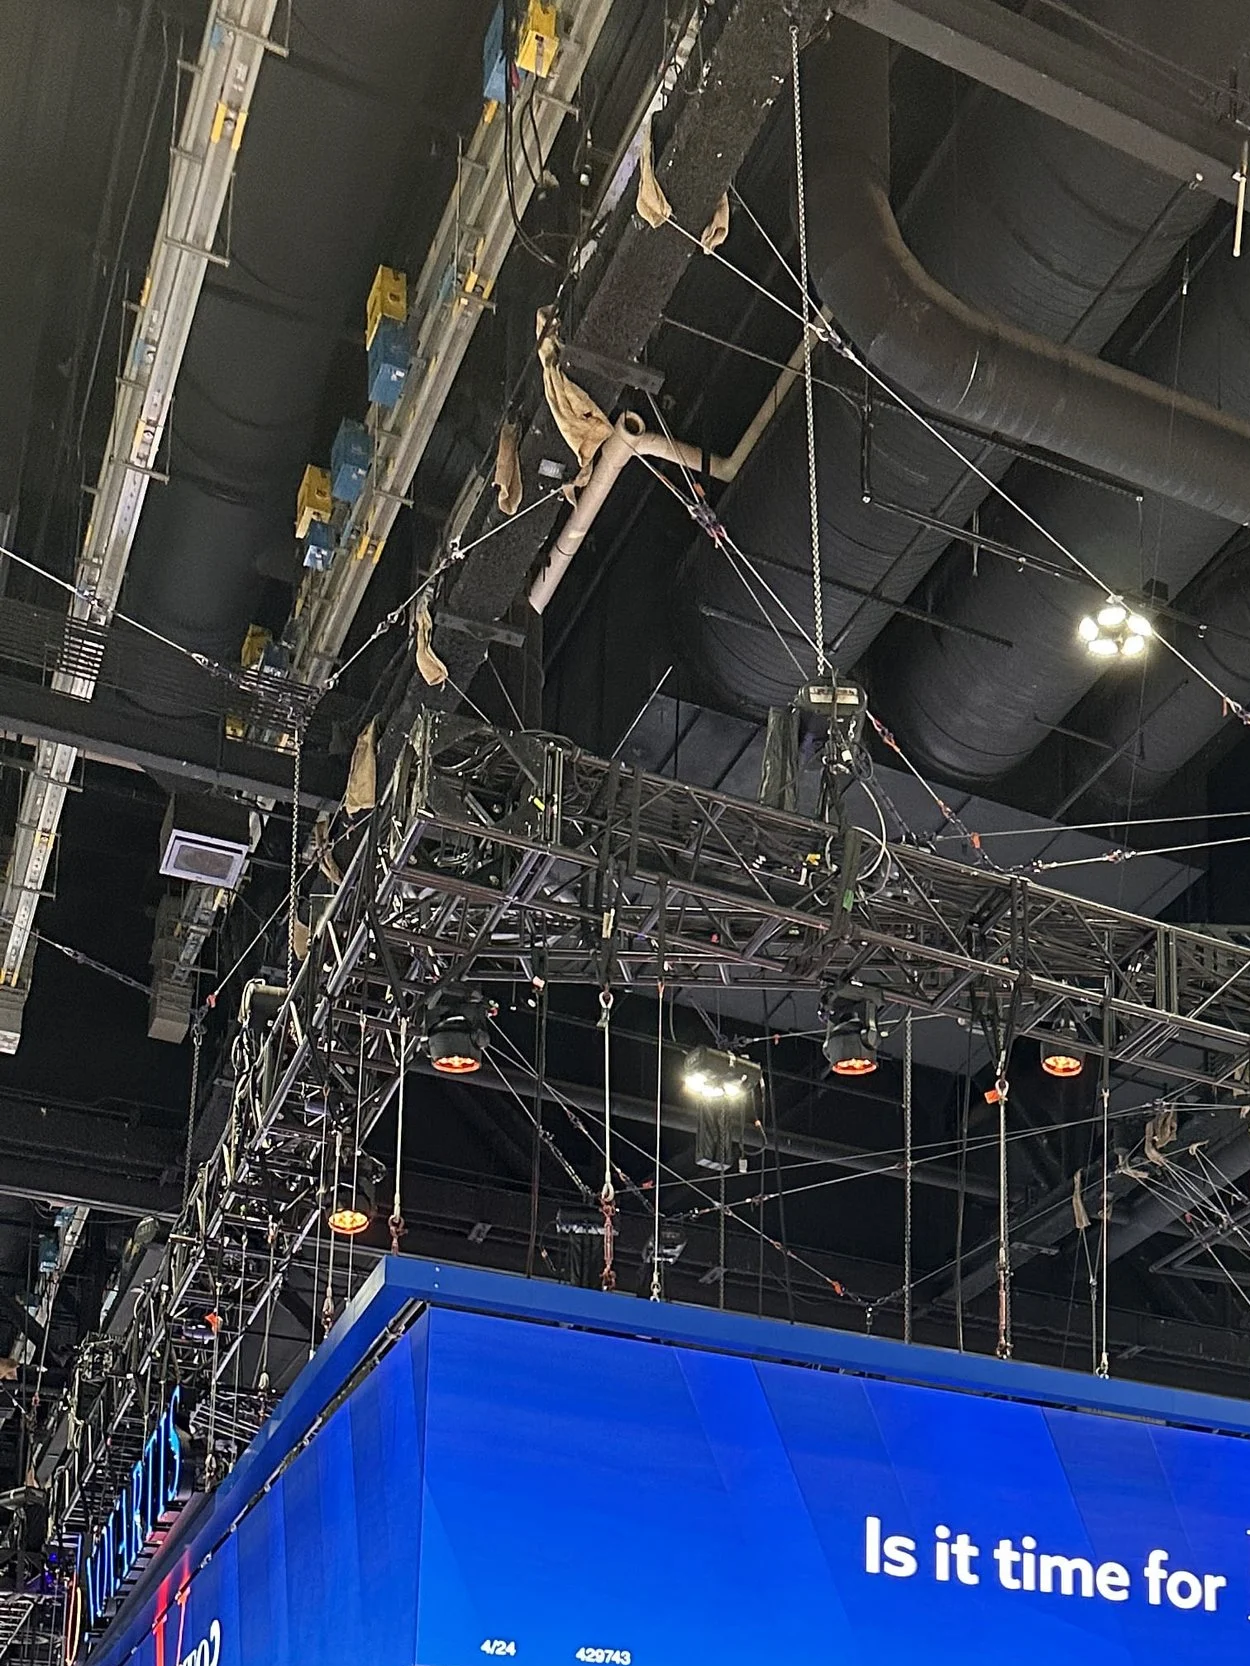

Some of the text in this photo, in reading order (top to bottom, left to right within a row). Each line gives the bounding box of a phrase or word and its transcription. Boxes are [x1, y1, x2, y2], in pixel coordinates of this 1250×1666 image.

[865, 1516, 917, 1579] Is
[935, 1525, 979, 1586] it
[994, 1538, 1129, 1603] time
[1144, 1548, 1227, 1612] for
[481, 1639, 516, 1656] 4/24
[576, 1647, 631, 1666] 429743
